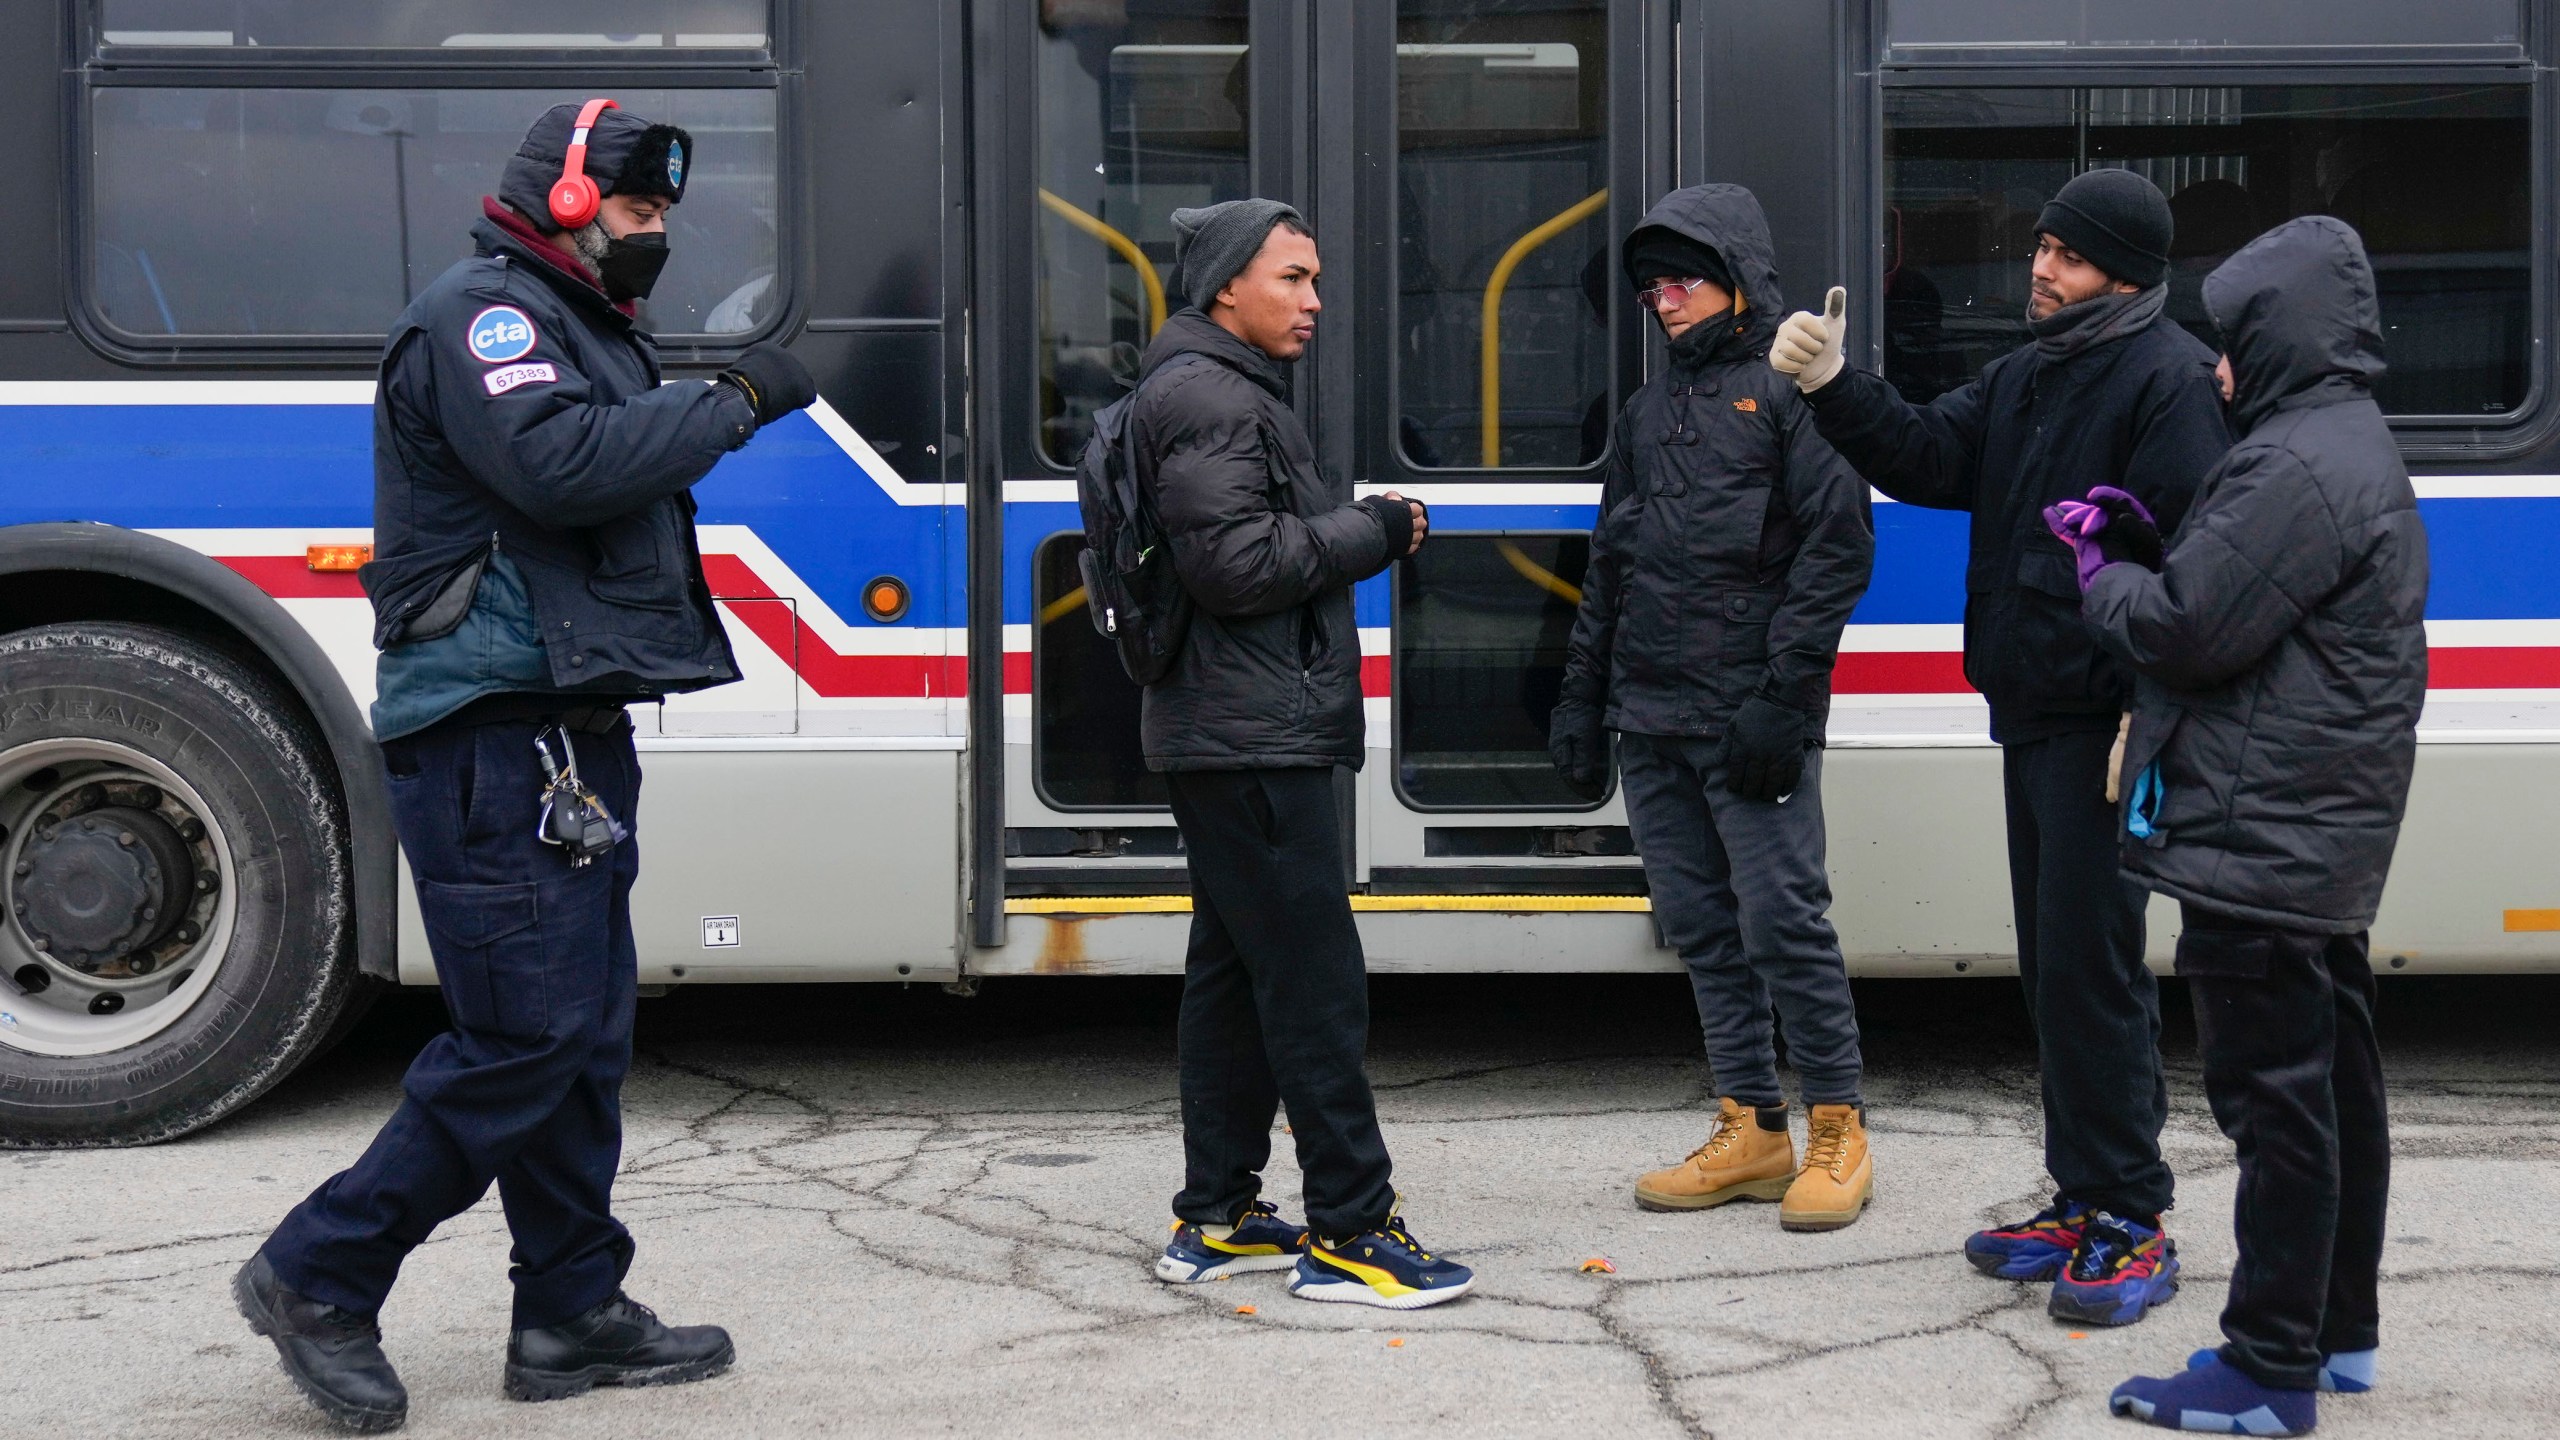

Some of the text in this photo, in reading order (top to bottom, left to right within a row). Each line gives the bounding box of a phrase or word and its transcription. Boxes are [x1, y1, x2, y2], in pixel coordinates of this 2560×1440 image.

[669, 156, 682, 173] cta
[475, 321, 527, 349] cta
[496, 368, 547, 388] 67389
[714, 921, 723, 929] TANK
[724, 920, 735, 928] DRAIN
[0, 1072, 98, 1095] MILE
